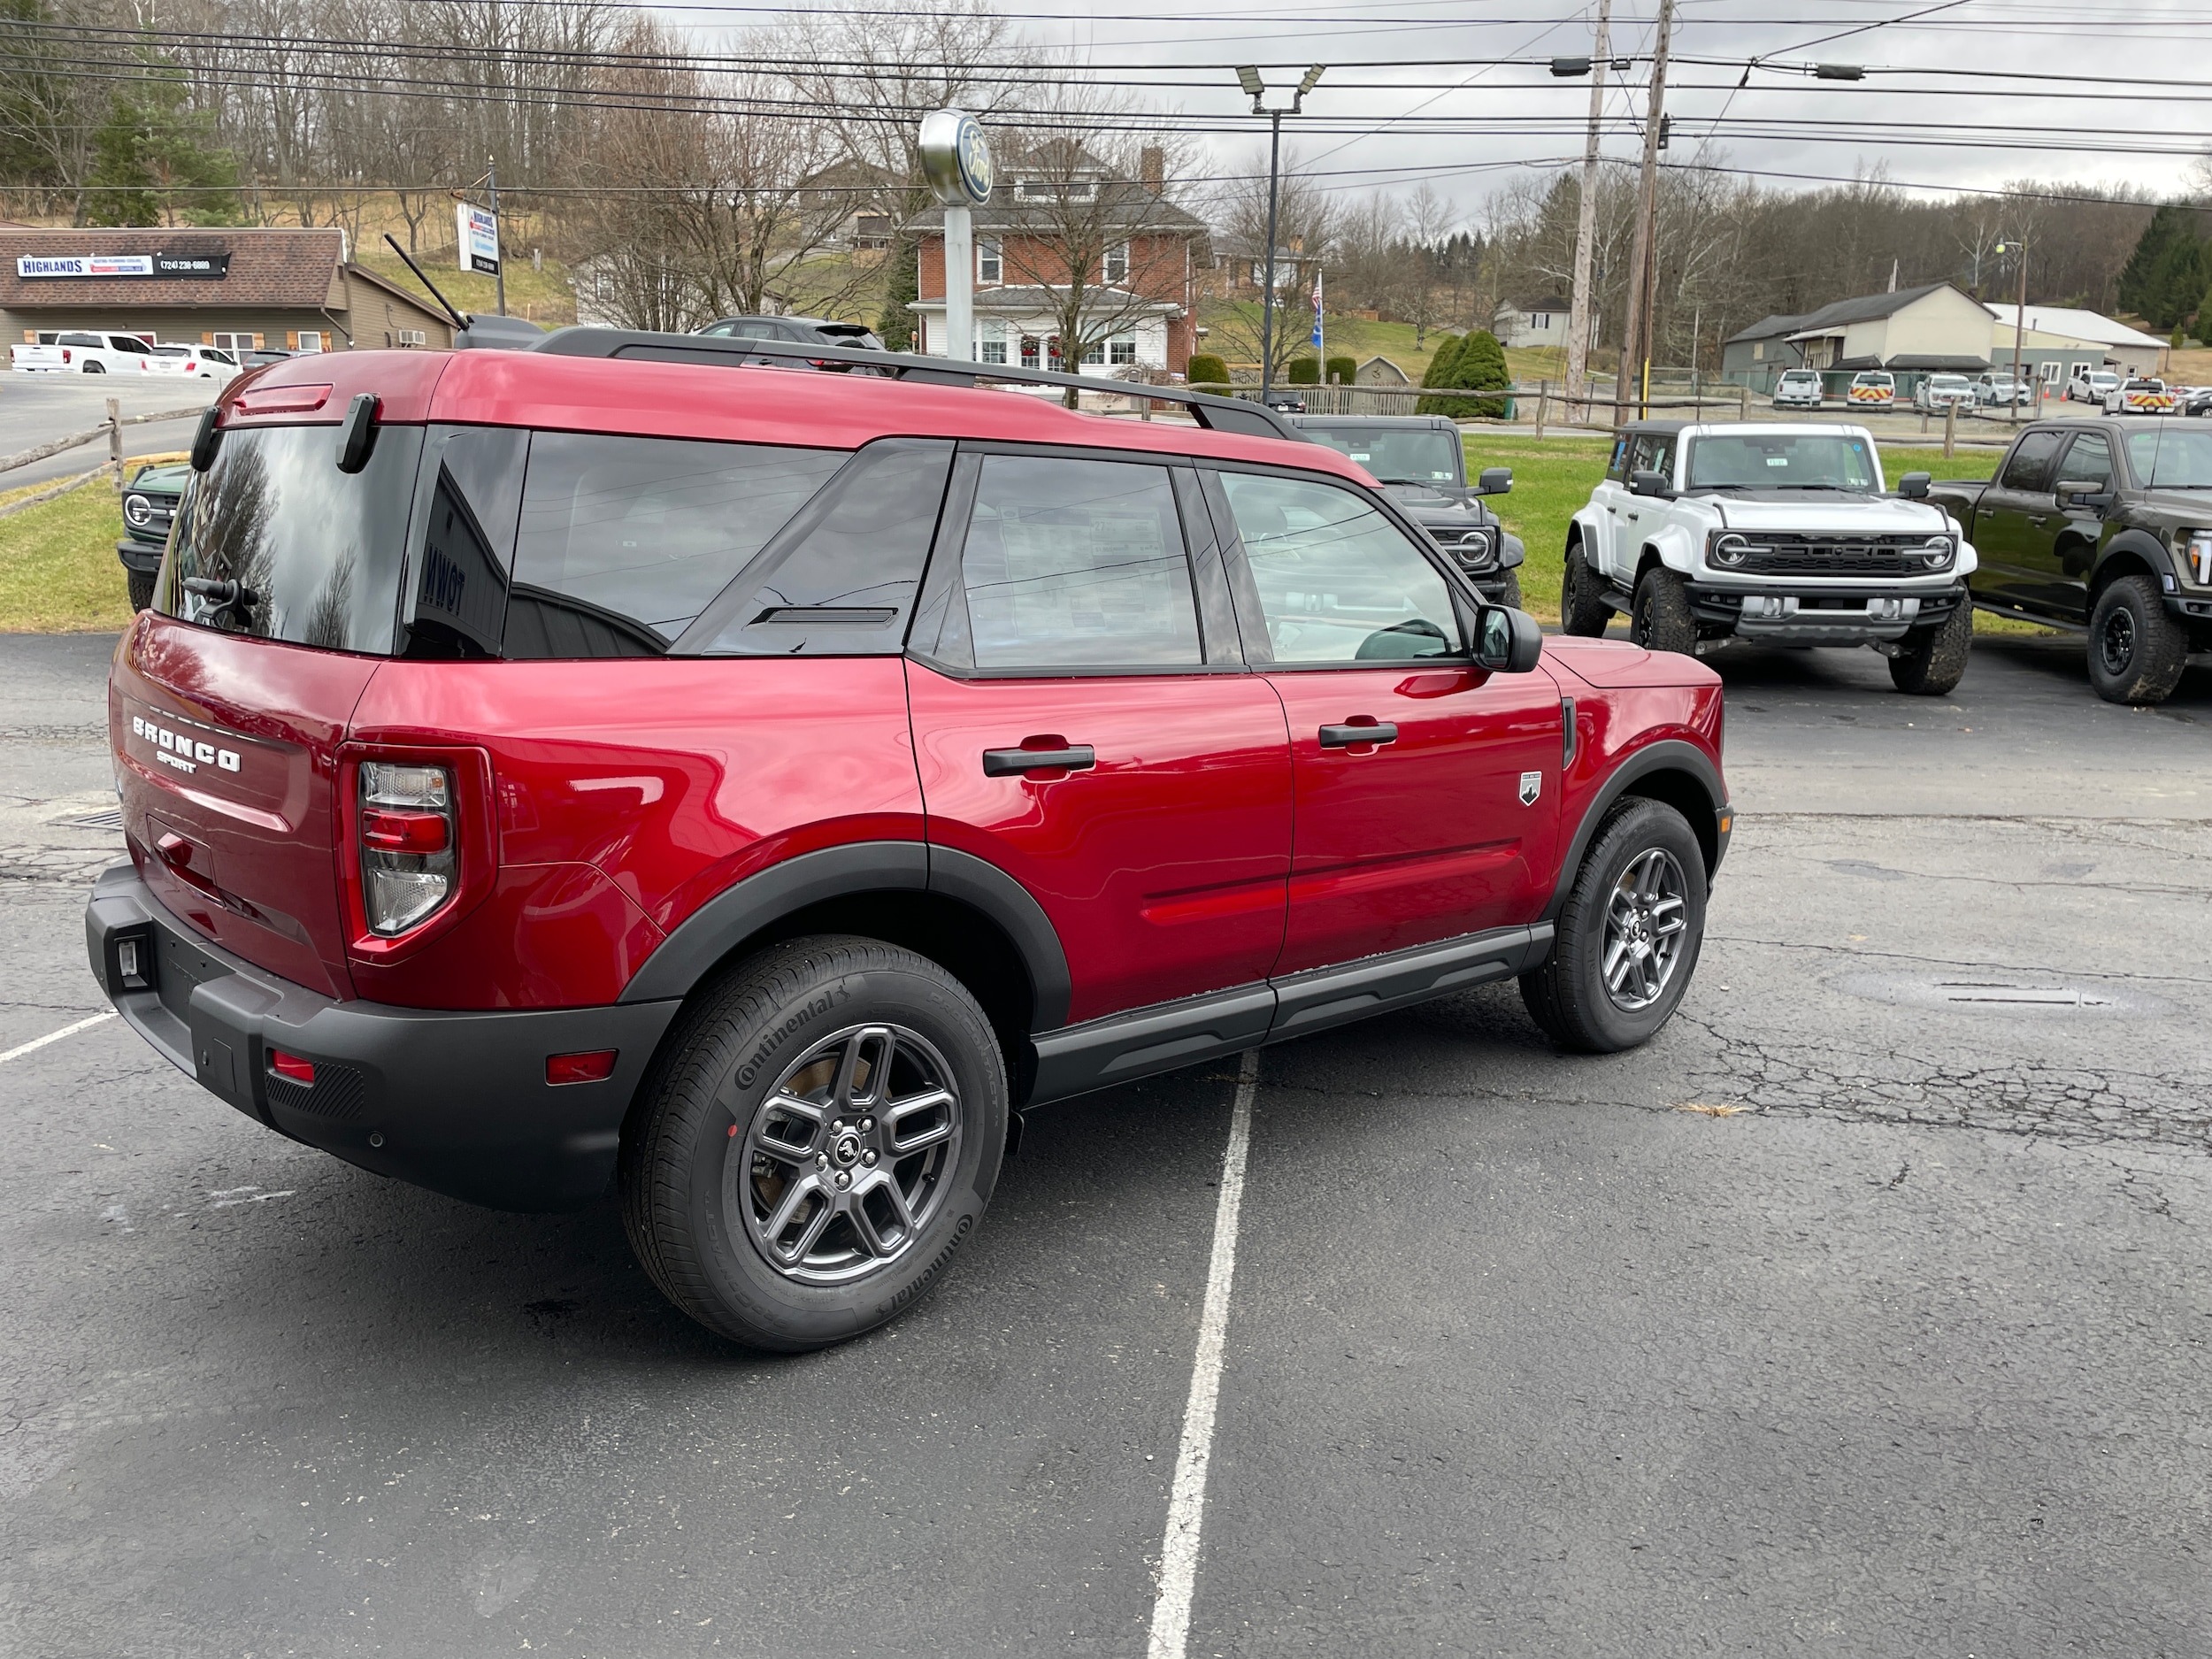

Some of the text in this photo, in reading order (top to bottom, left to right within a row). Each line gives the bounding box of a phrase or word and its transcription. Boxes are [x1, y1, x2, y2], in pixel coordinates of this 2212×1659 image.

[968, 130, 991, 188] Ford
[23, 260, 82, 273] HIGHLANDS
[160, 260, 178, 269] (724)
[1775, 543, 1901, 561] FORD
[133, 715, 242, 772] BRONCO
[156, 749, 197, 774] SPORT
[734, 990, 834, 1091] Continental
[889, 1214, 973, 1310] Continental
